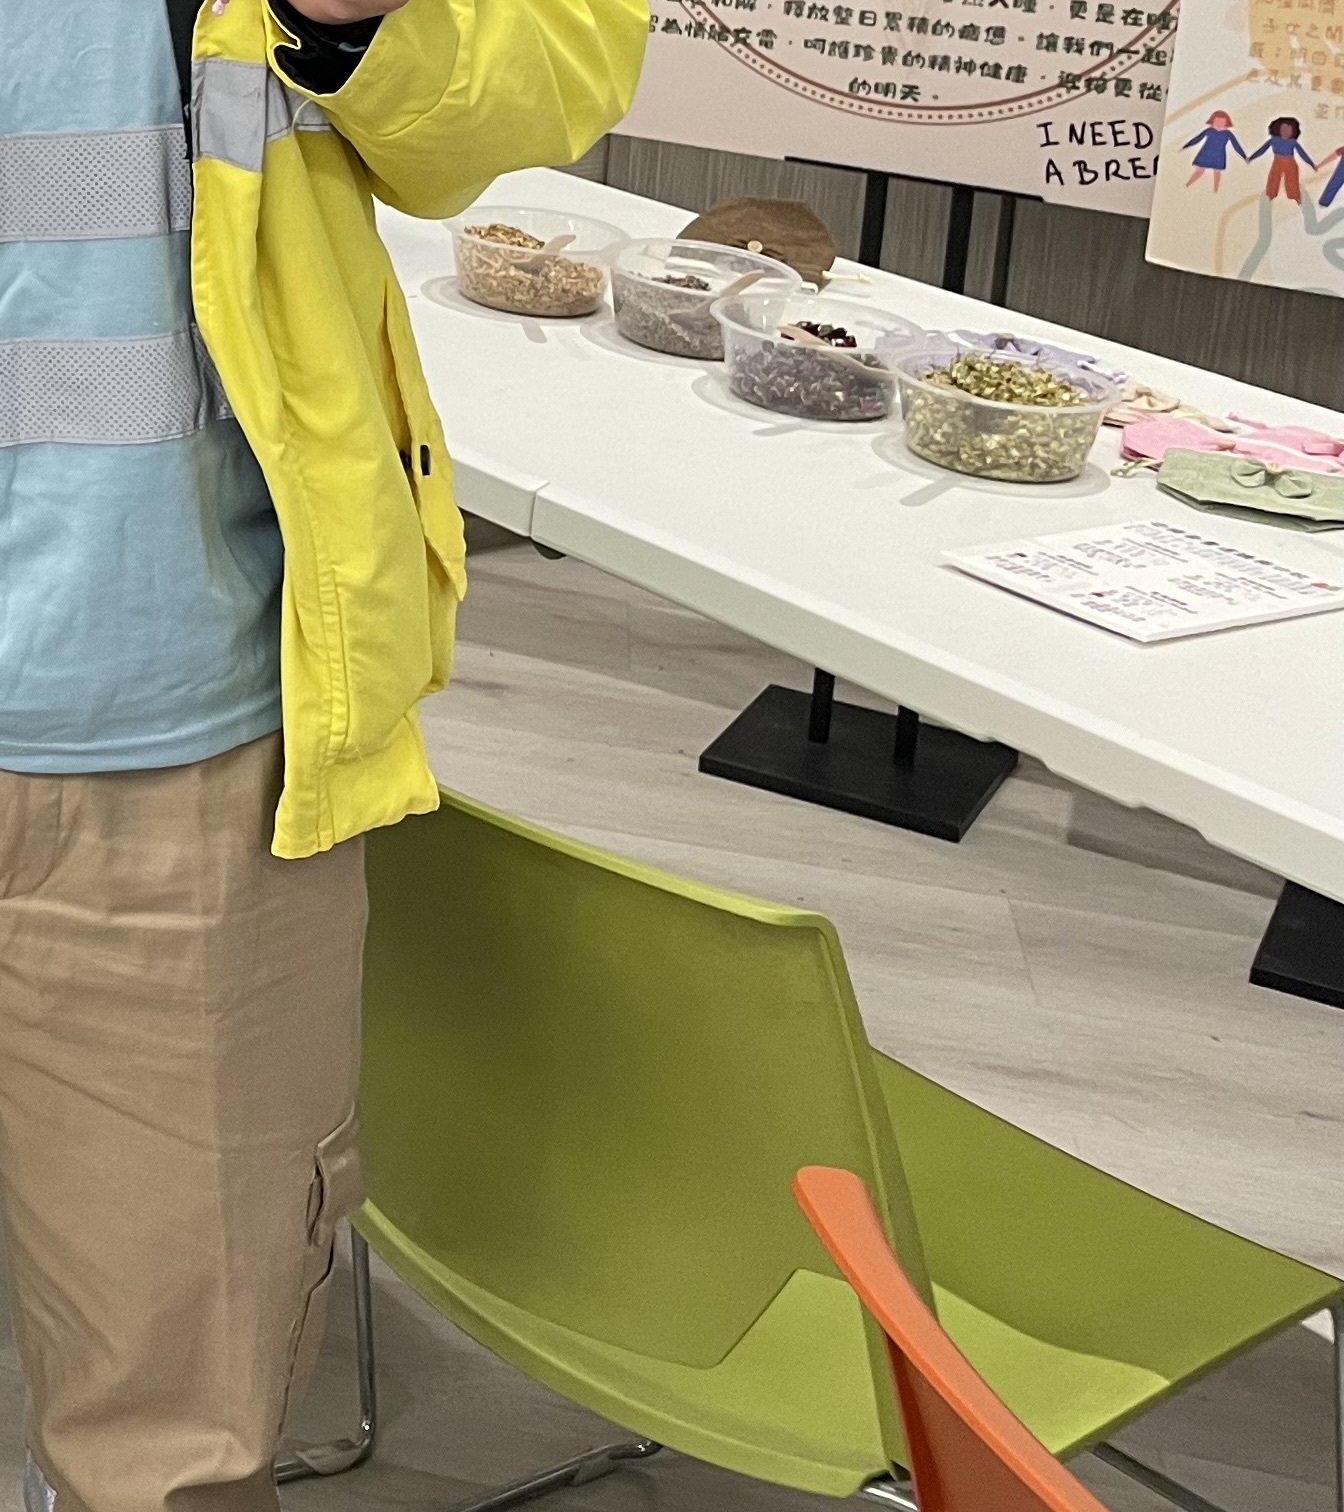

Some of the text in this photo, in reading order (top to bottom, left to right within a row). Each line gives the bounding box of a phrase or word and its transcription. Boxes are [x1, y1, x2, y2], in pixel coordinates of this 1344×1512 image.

[1036, 119, 1154, 149] I NEED
[1045, 158, 1065, 186] A
